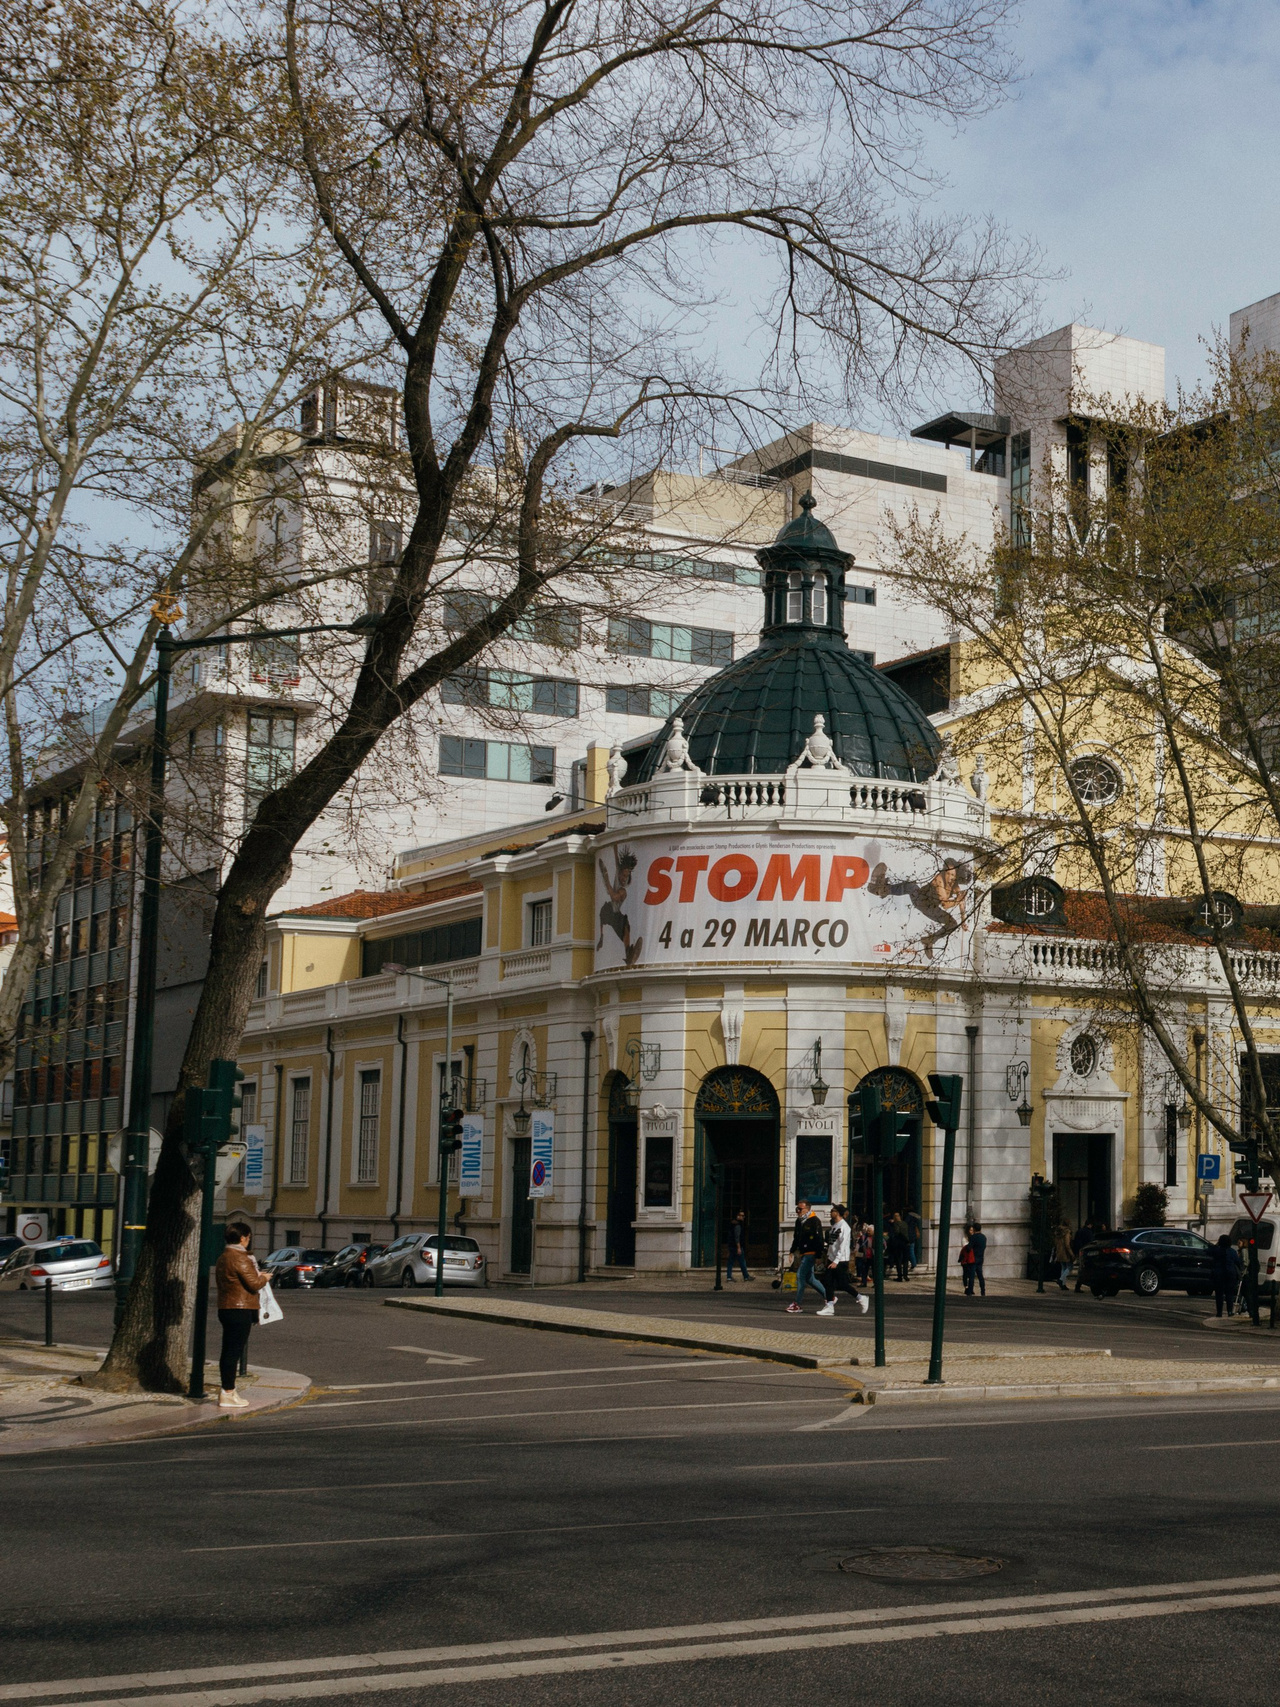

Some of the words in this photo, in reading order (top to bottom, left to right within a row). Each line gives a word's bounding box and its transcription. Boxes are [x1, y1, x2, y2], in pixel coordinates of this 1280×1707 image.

[643, 853, 870, 906] STOMP
[659, 921, 672, 949] 4
[680, 928, 694, 948] a
[702, 918, 737, 948] 29
[744, 918, 849, 955] MARÇO
[646, 1120, 674, 1131] TIVOLI
[797, 1119, 834, 1130] TIVOLI
[246, 1147, 263, 1179] TIVOLI
[462, 1139, 481, 1178] TIVOLI
[532, 1137, 552, 1178] TIVO
[1203, 1157, 1215, 1176] P
